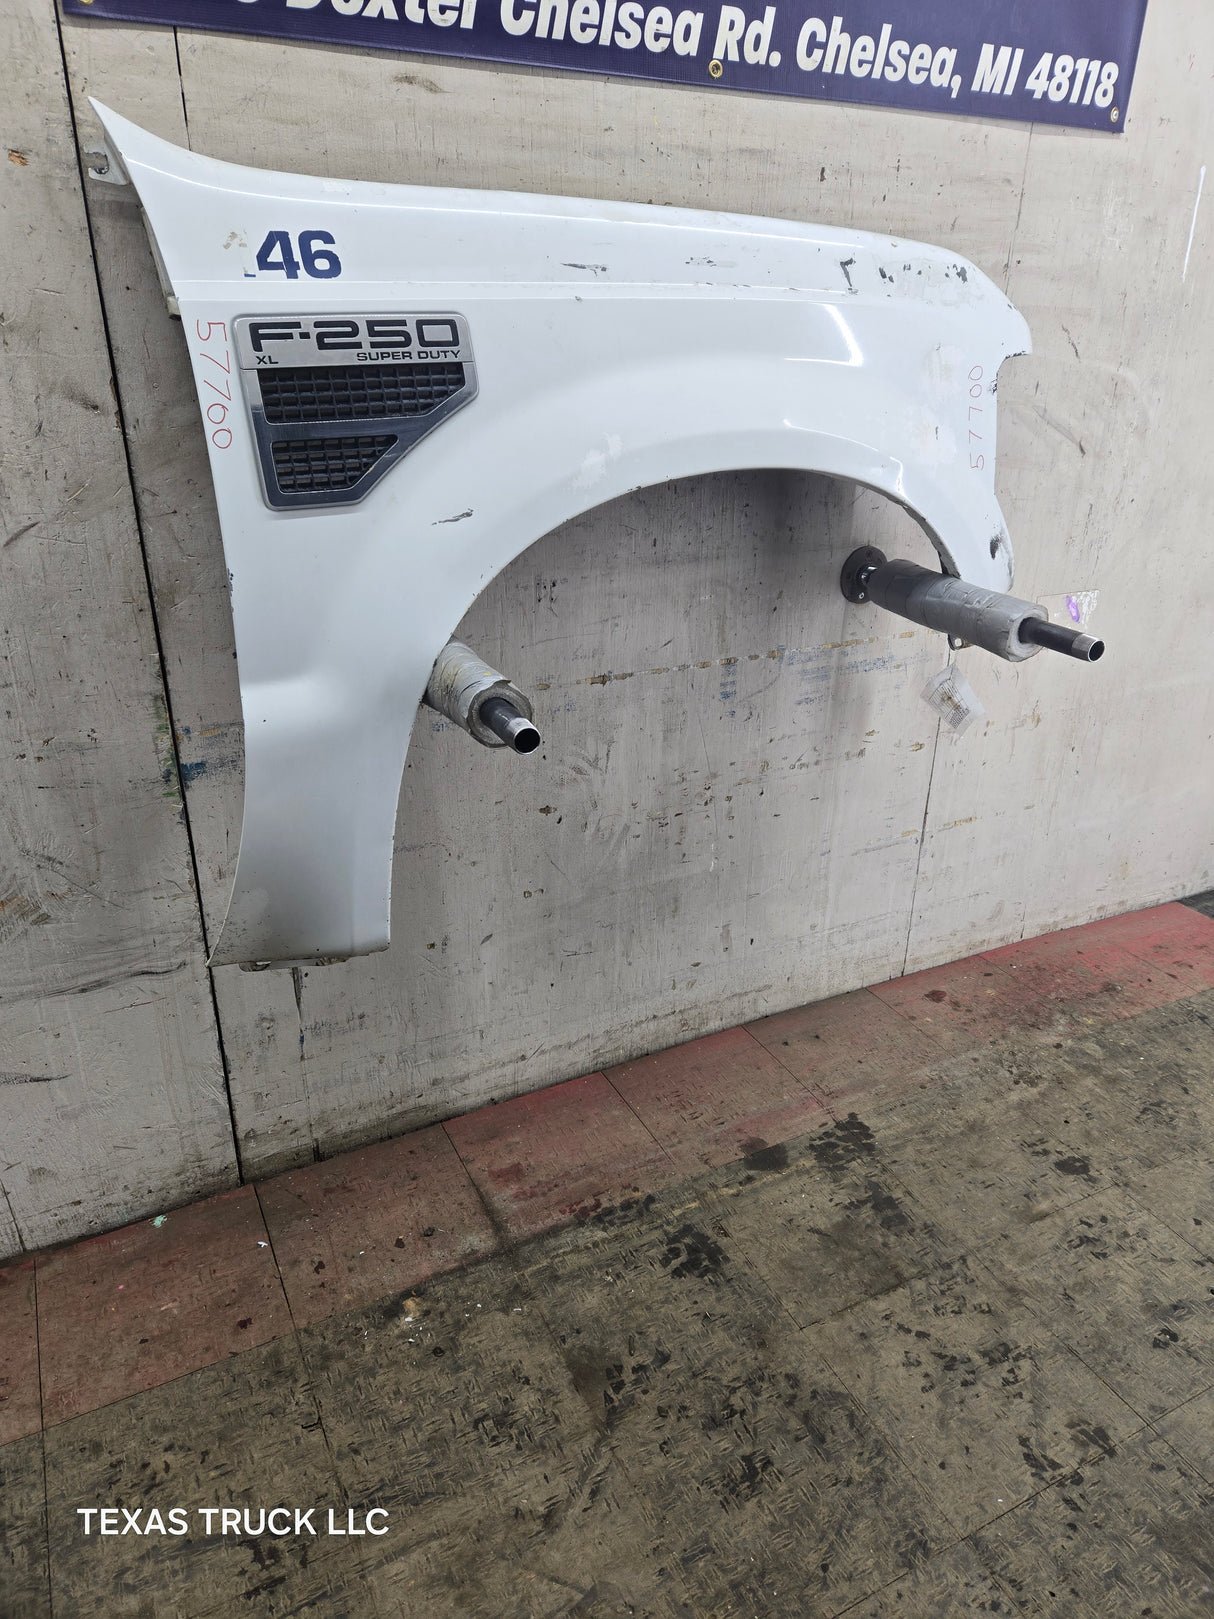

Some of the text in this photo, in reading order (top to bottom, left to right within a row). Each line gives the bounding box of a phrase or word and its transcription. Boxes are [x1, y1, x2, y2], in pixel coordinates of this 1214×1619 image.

[500, 0, 704, 57] Chelsea
[712, 5, 782, 67] Rd.
[796, 16, 962, 98] Chelsea,
[971, 43, 1024, 96] MI
[1025, 52, 1119, 108] 48118
[249, 319, 460, 352] F-250
[256, 355, 279, 365] XL
[356, 350, 460, 362] SUPER DUTY
